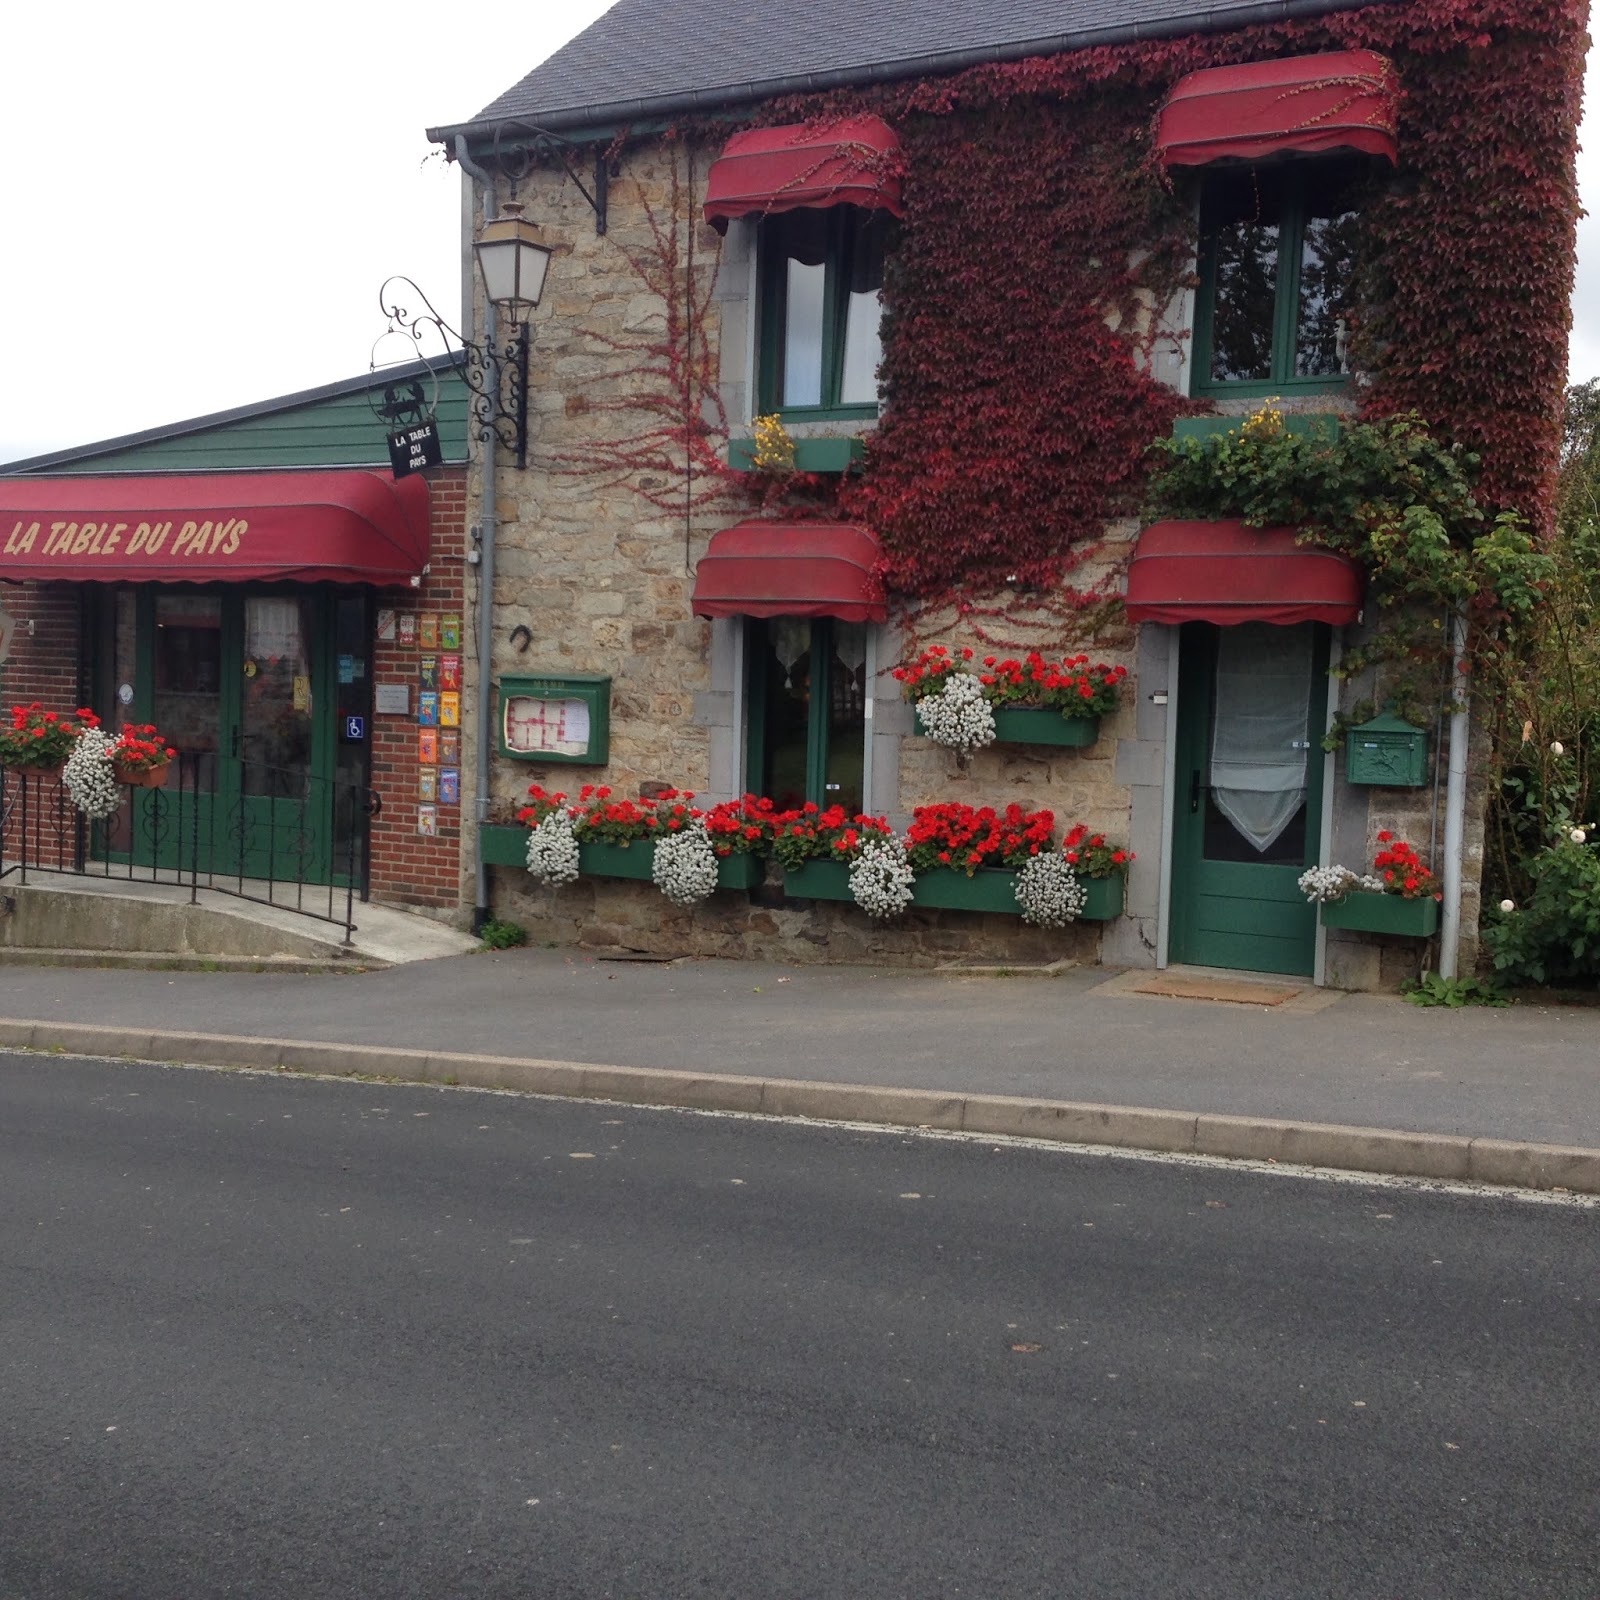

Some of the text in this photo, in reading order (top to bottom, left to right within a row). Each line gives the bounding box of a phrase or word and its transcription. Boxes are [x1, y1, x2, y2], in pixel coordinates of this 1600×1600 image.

[395, 426, 432, 447] LA TABLE
[410, 443, 422, 455] DU
[409, 455, 427, 468] PAYS
[4, 517, 249, 556] LA TABLE DU PAYS
